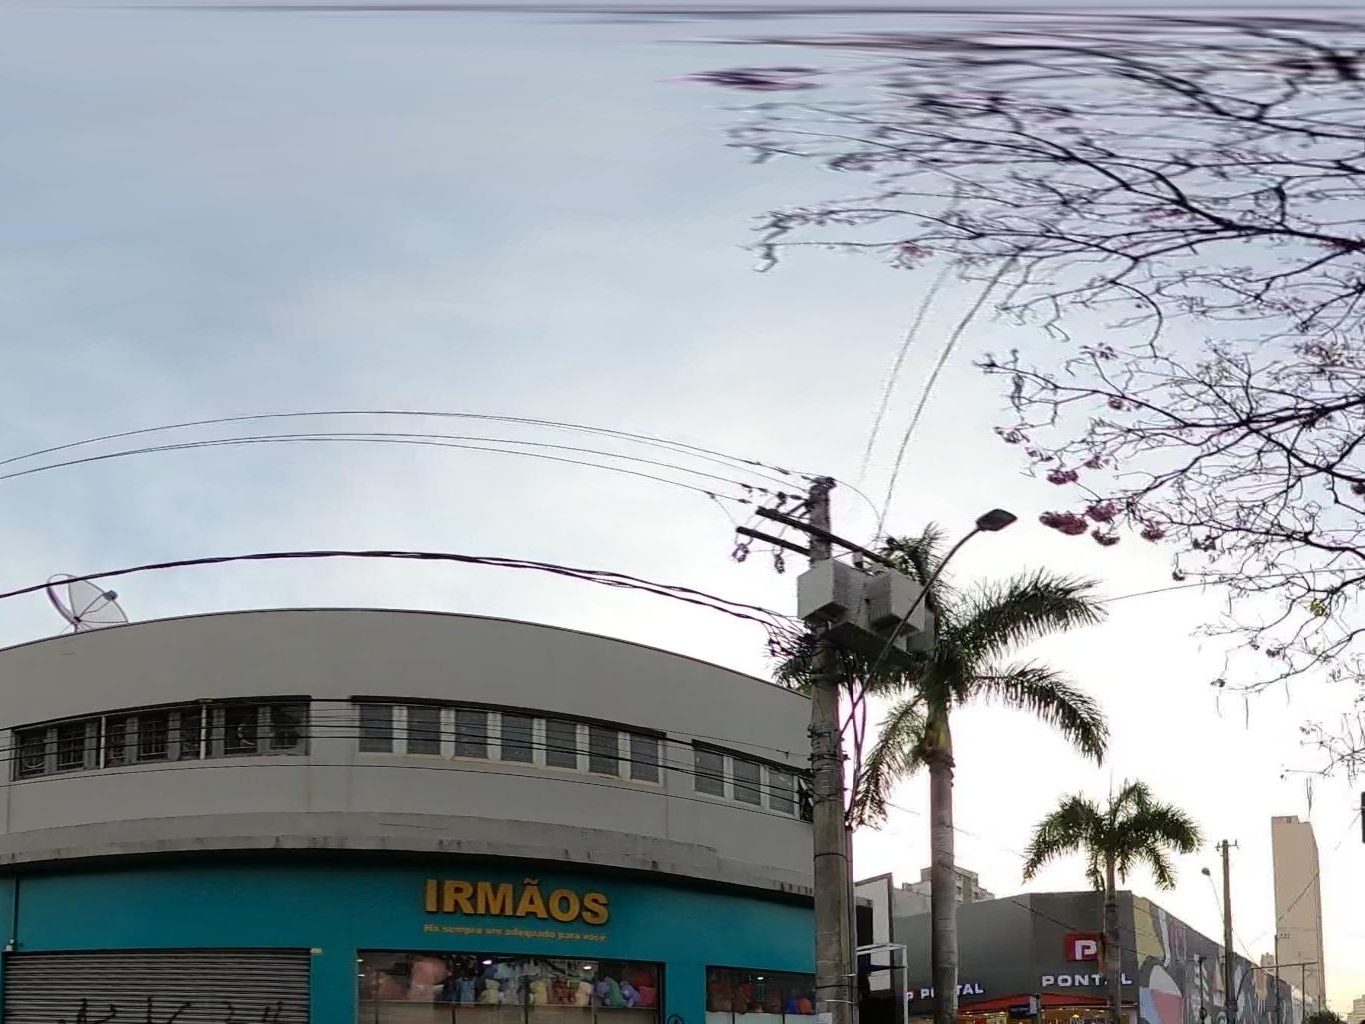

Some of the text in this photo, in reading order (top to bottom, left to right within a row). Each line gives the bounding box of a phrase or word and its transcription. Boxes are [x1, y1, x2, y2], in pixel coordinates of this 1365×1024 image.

[425, 878, 610, 925] IRMÃOS
[1042, 972, 1132, 988] PONTL
[920, 983, 984, 999] PTAL
